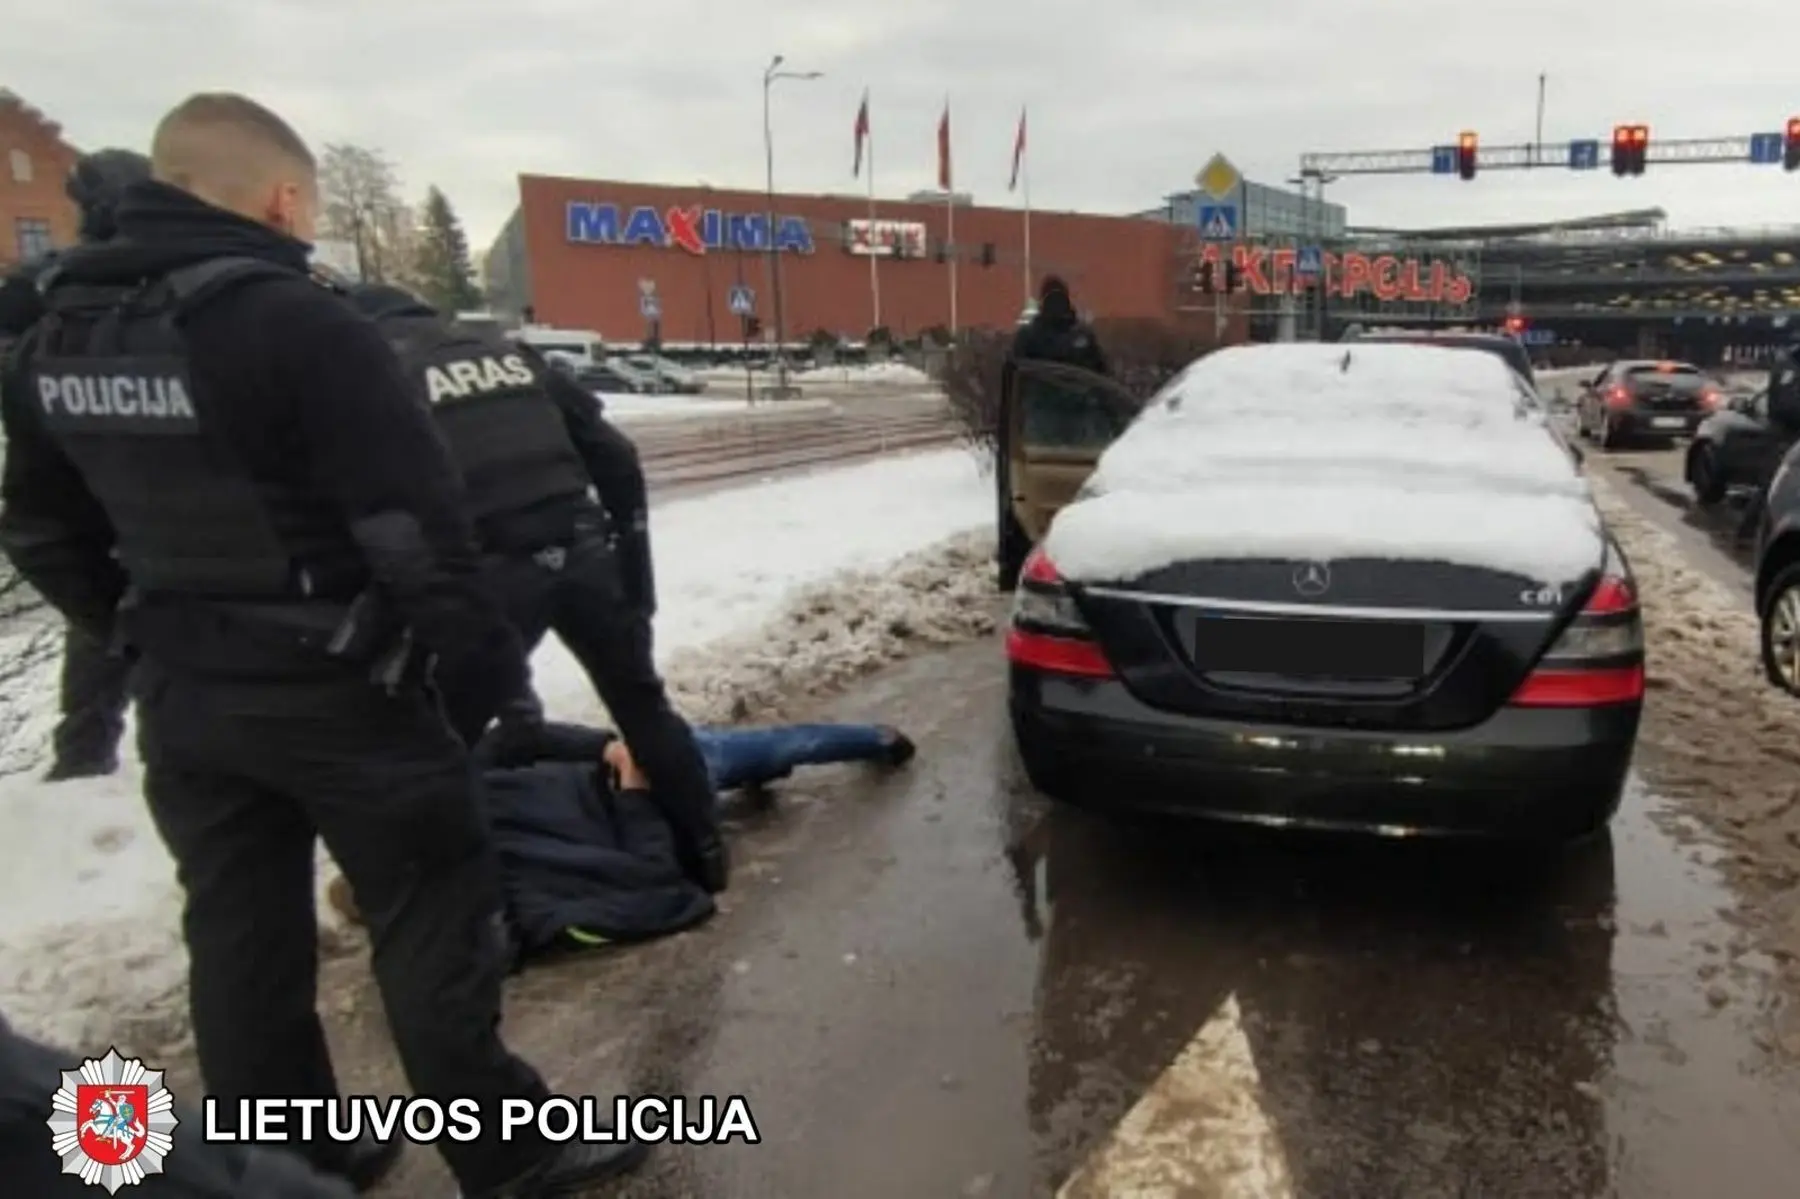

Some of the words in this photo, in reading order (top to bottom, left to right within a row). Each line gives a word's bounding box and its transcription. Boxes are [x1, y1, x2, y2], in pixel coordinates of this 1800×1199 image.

[567, 201, 815, 255] MAXIMA
[38, 373, 194, 417] POLICIJA
[425, 353, 534, 402] ARAS
